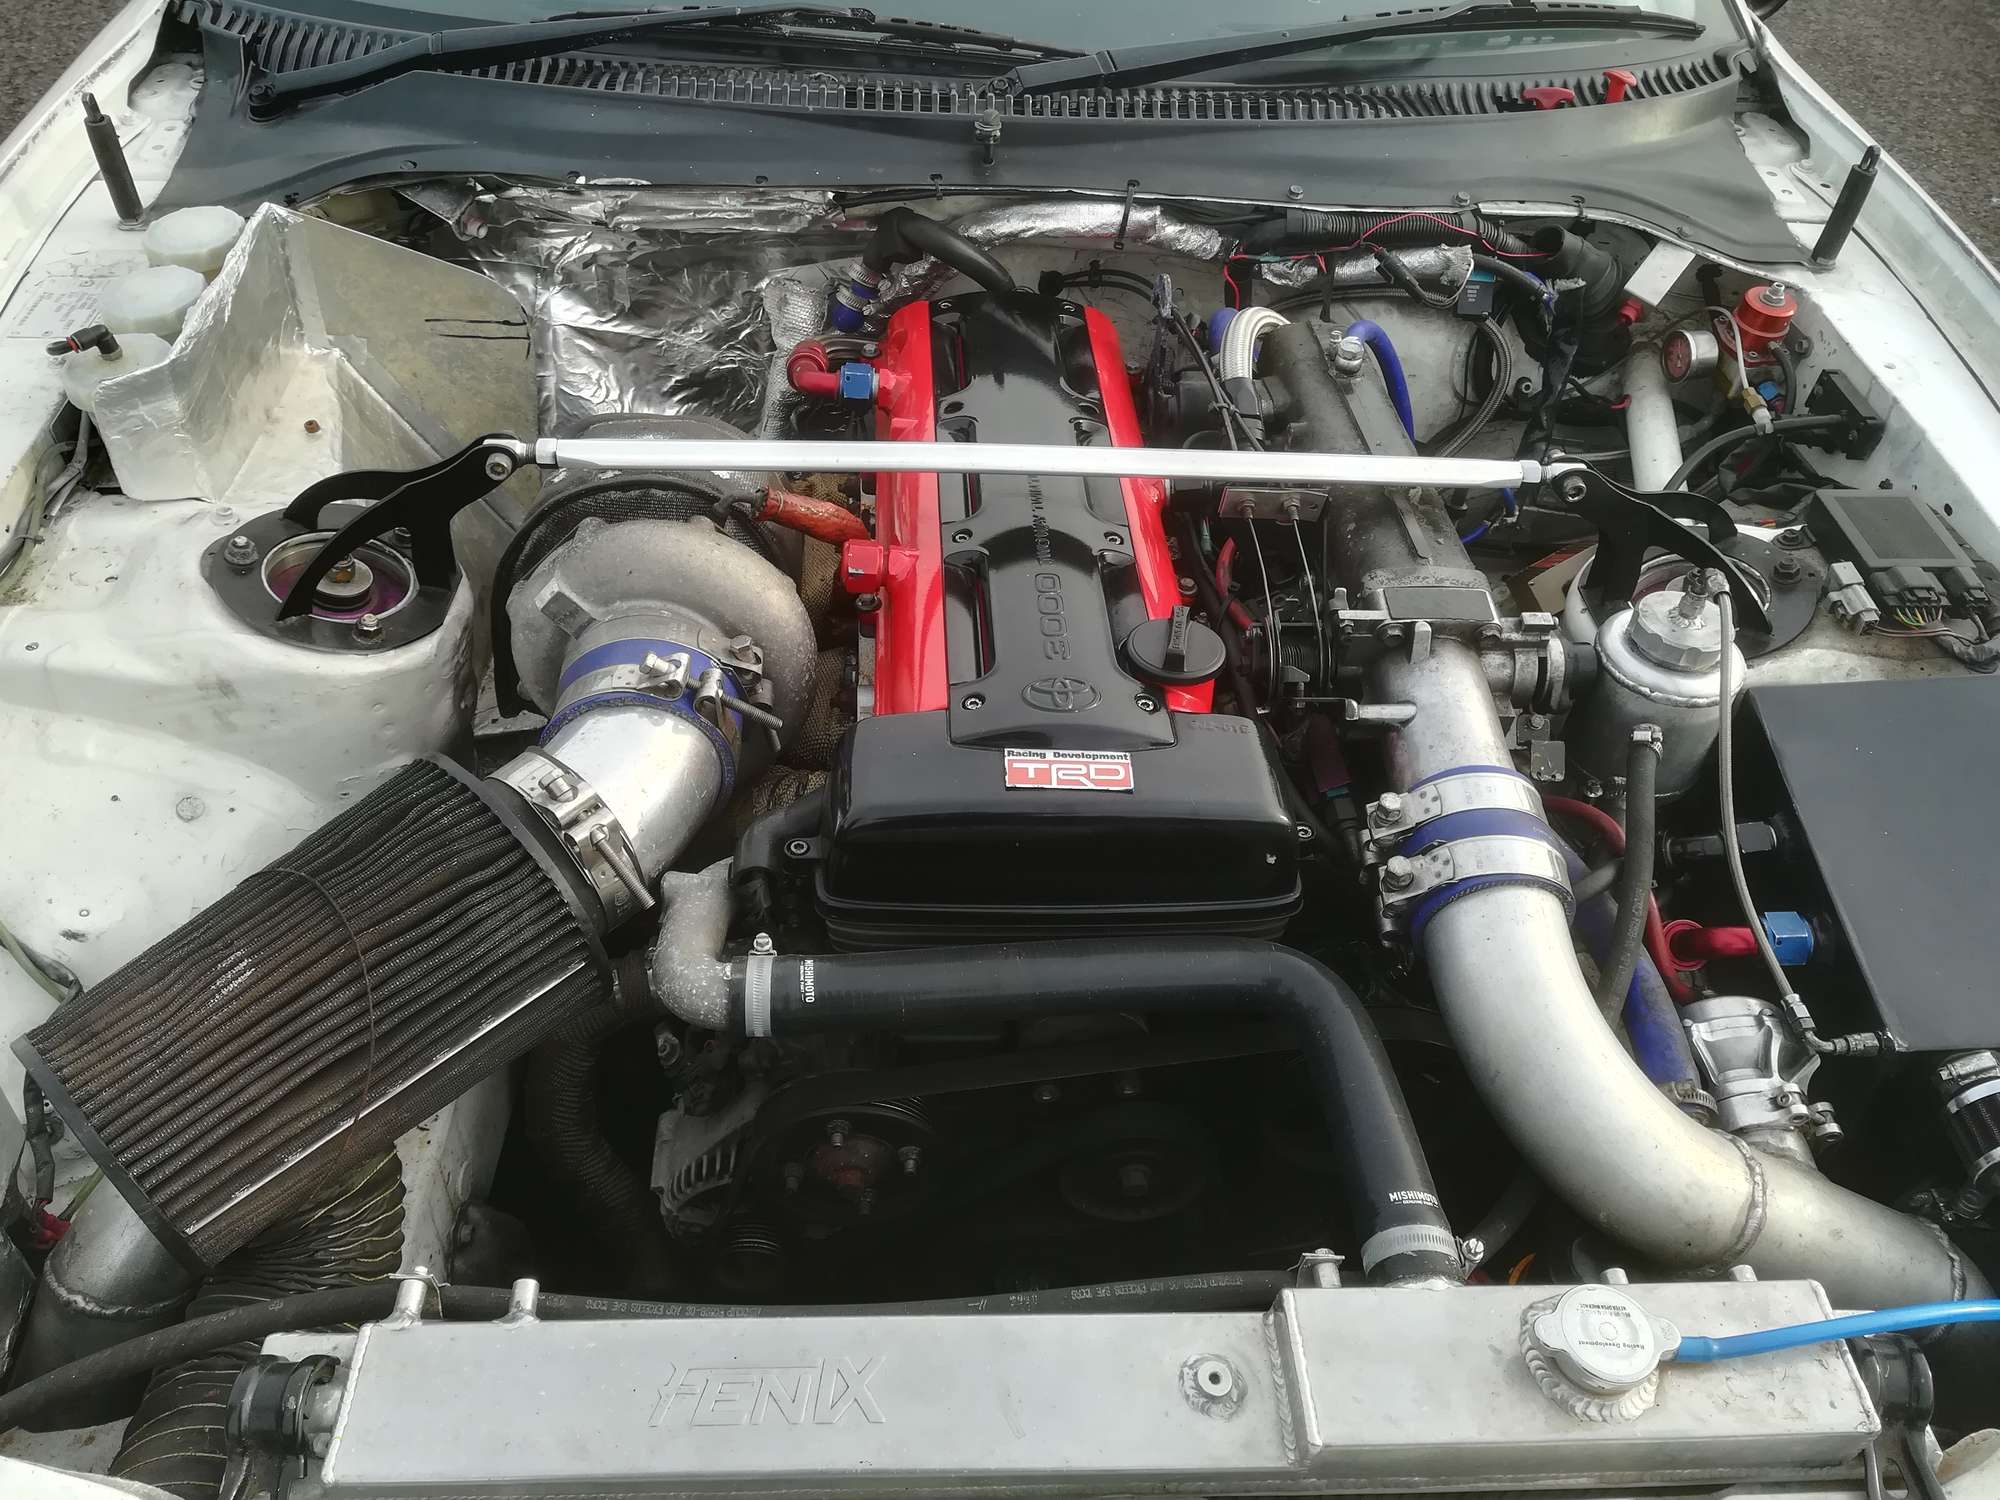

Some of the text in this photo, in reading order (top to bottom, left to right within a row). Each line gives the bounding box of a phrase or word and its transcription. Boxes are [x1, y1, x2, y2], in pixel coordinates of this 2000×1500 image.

[1035, 572, 1071, 661] 3000
[1007, 750, 1129, 761] Racing Development
[1012, 762, 1126, 788] TRD
[804, 959, 815, 1003] MISHIMOTO
[648, 1356, 887, 1427] FENIX
